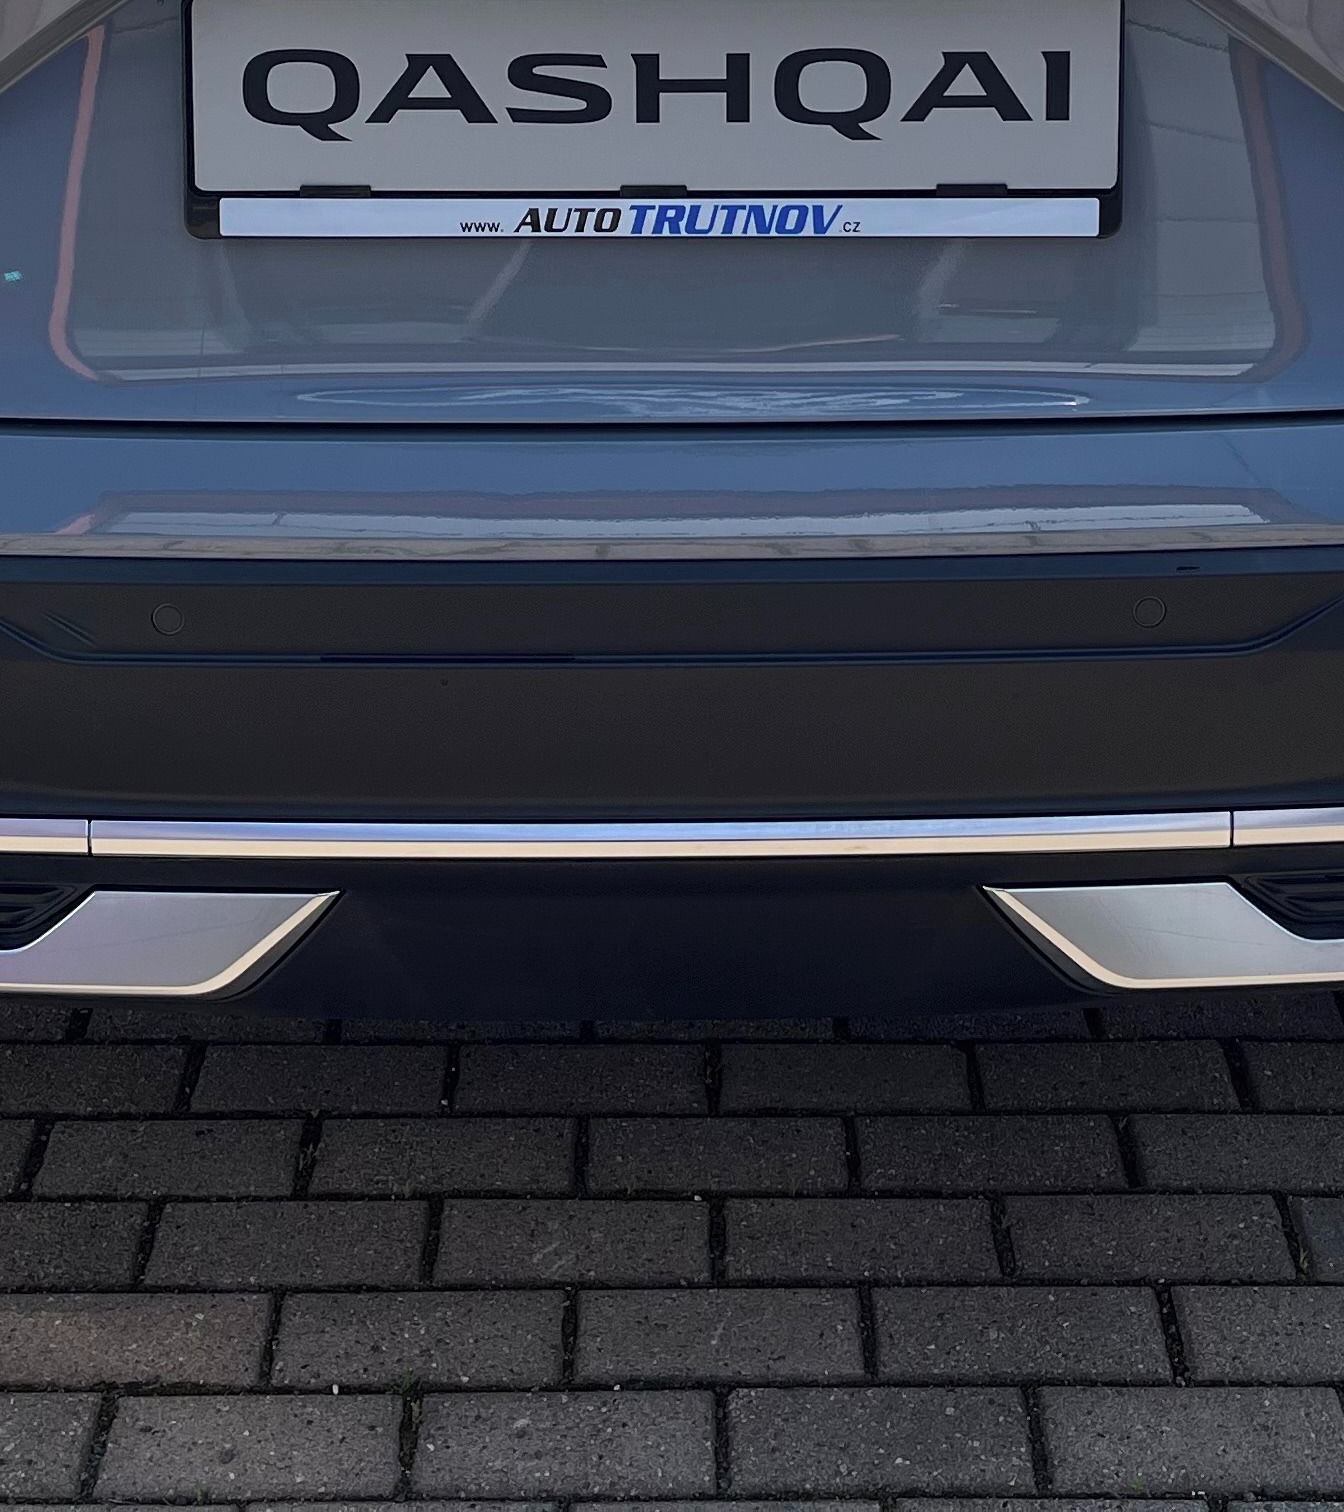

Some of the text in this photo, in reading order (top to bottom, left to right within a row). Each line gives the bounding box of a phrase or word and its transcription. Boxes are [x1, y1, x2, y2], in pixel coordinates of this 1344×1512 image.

[241, 48, 1072, 142] QASHQAI
[513, 207, 622, 233] AUTO
[628, 204, 843, 235] TRUTNOV
